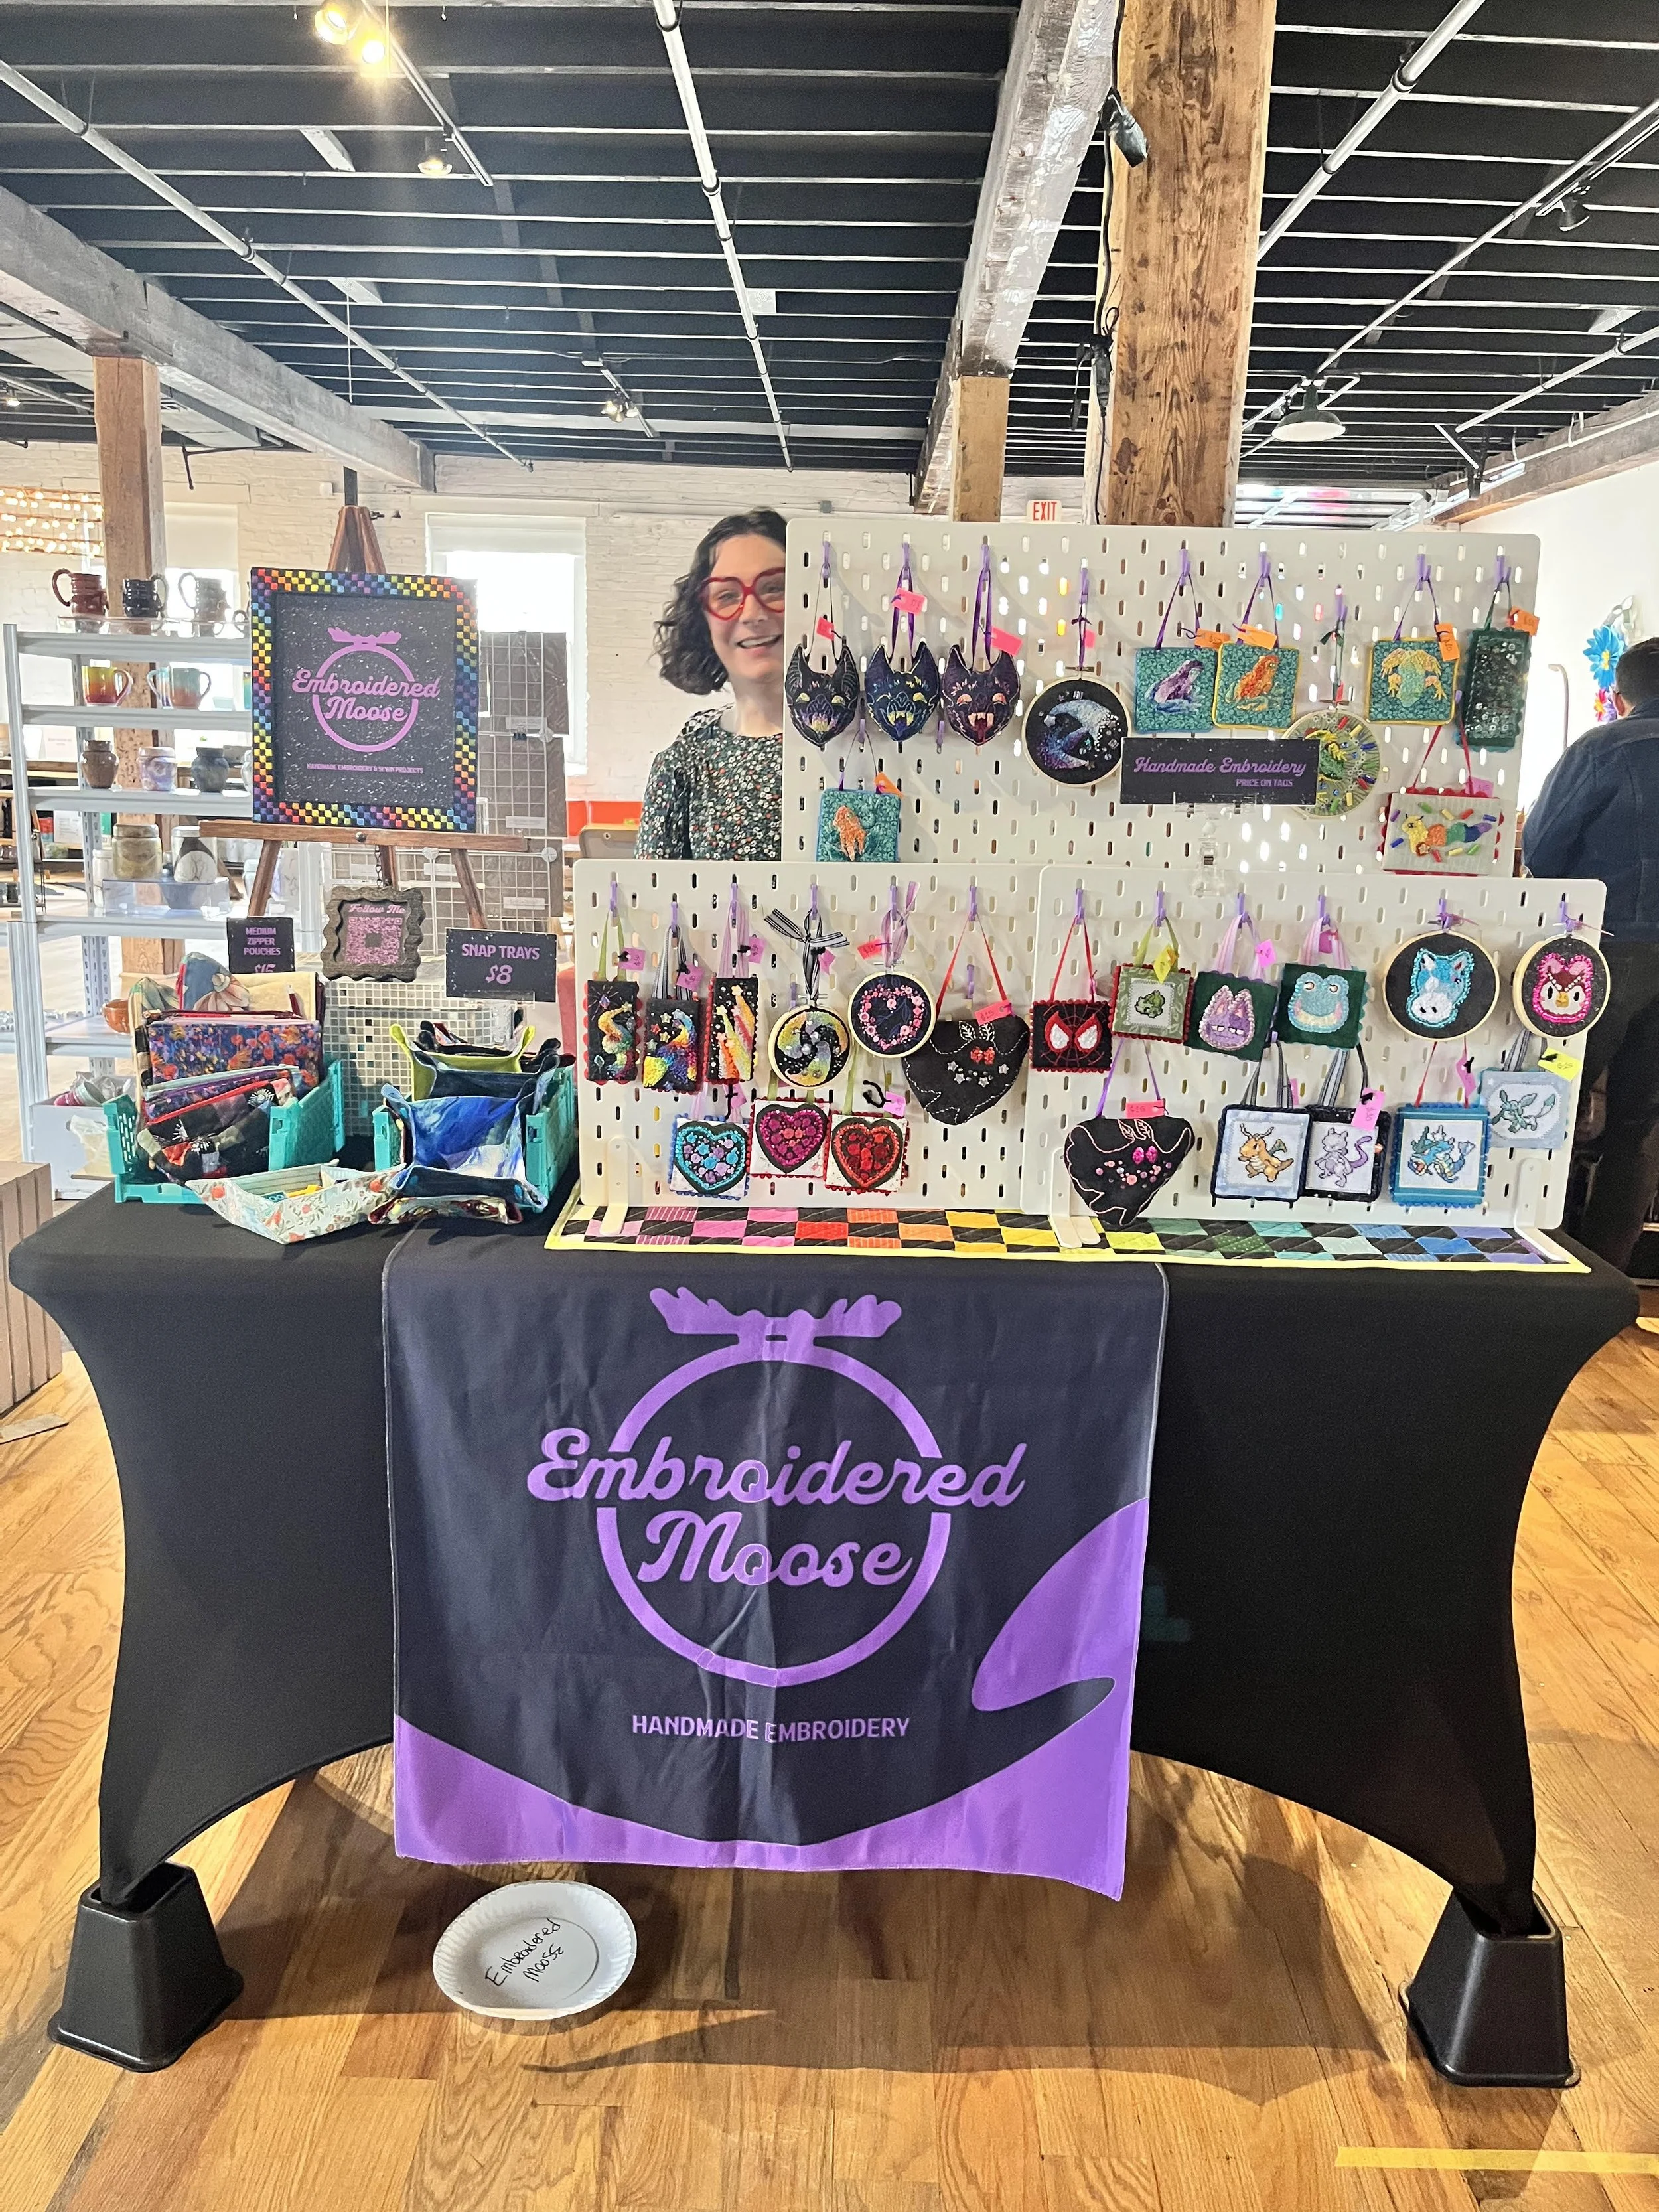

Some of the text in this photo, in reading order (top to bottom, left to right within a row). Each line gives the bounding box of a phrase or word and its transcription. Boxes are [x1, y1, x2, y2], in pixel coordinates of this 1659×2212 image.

[1033, 501, 1057, 521] EXIT
[292, 669, 441, 698] Embroidered
[324, 696, 407, 721] Moose
[1133, 757, 1307, 776] Handmade Embroidery
[348, 903, 406, 914] Follow Me
[461, 944, 540, 960] SNAP TRAYS
[485, 964, 513, 984] $8
[527, 1427, 1027, 1507] Embroidered
[637, 1510, 913, 1587] Moose
[632, 1714, 910, 1743] HANDMADE EMBROIDERY
